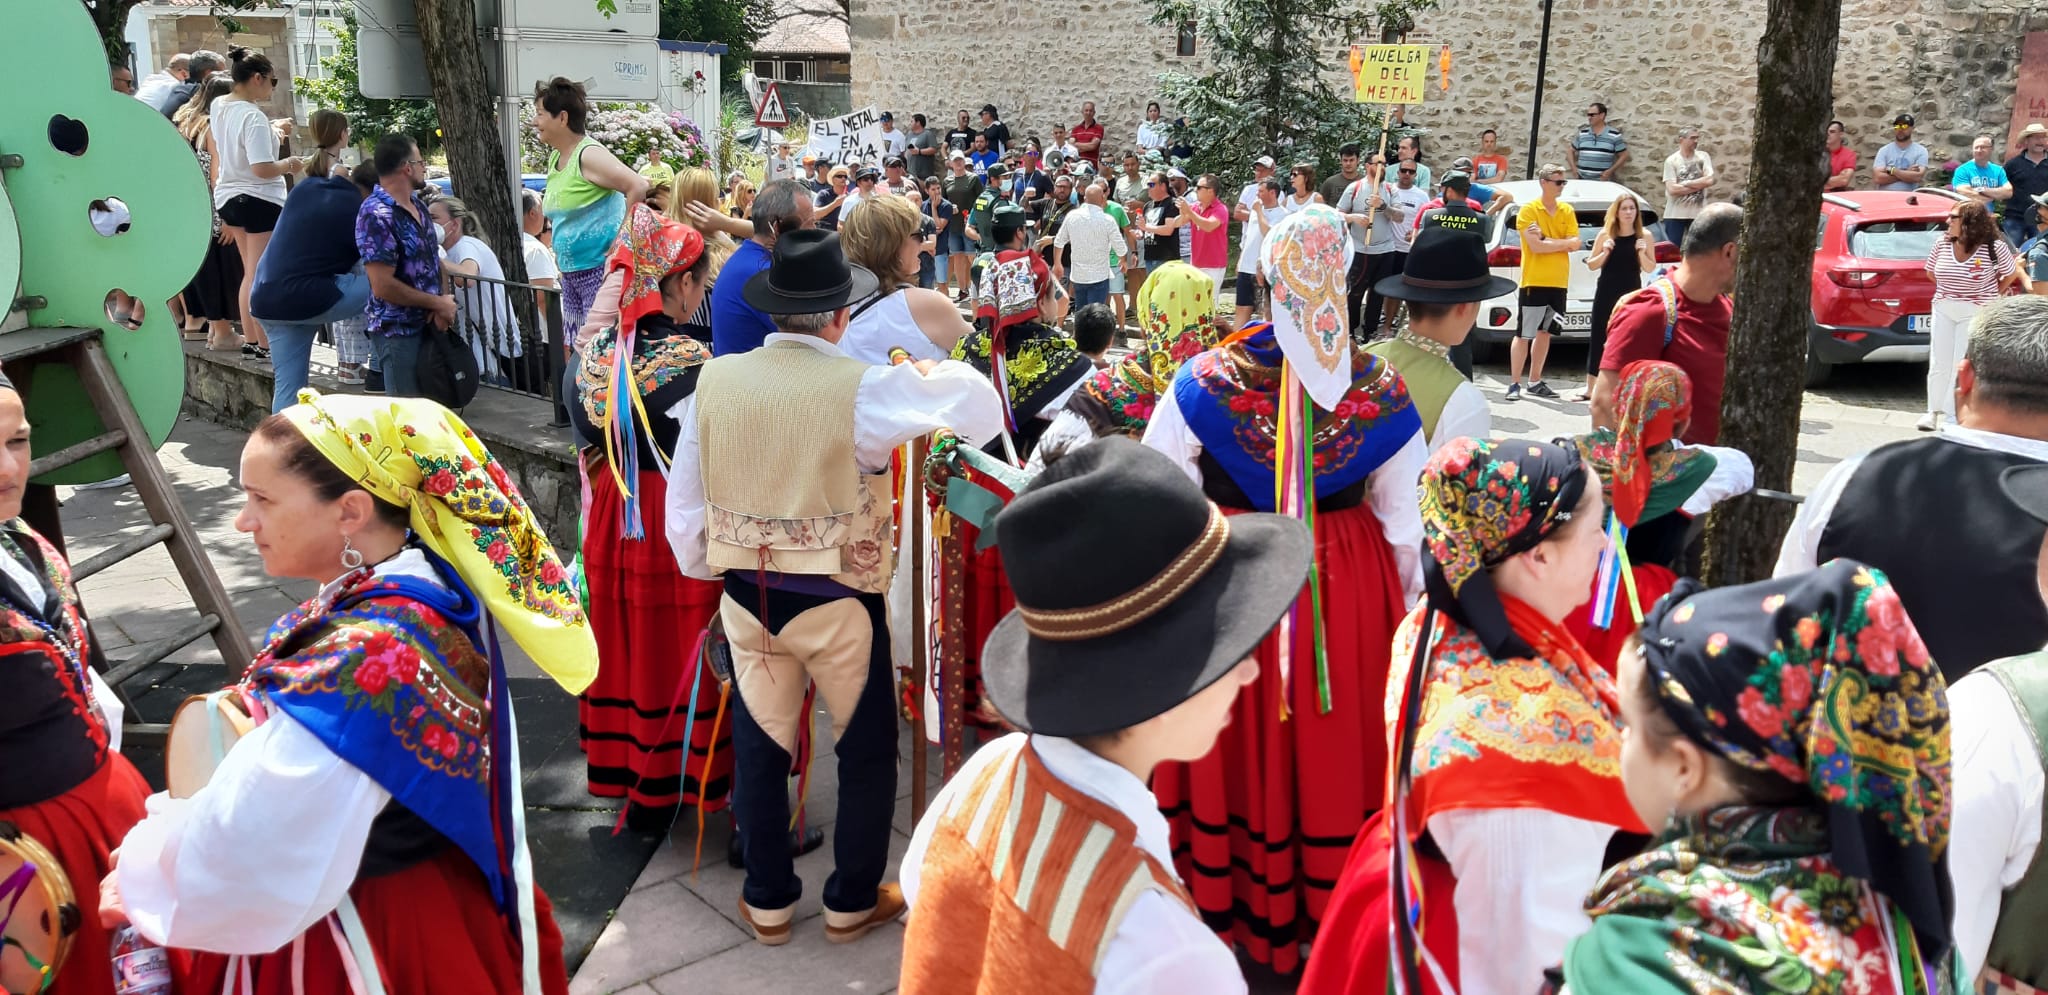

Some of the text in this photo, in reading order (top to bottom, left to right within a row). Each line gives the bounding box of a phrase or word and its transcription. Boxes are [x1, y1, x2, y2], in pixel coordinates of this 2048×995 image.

[1370, 50, 1421, 64] HUELGA
[1380, 67, 1409, 80] DEL
[1367, 85, 1417, 100] METAL
[815, 109, 879, 136] EL METAL
[841, 133, 859, 149] EN
[1432, 214, 1478, 224] GUARDIA
[1441, 221, 1467, 229] CIVIL
